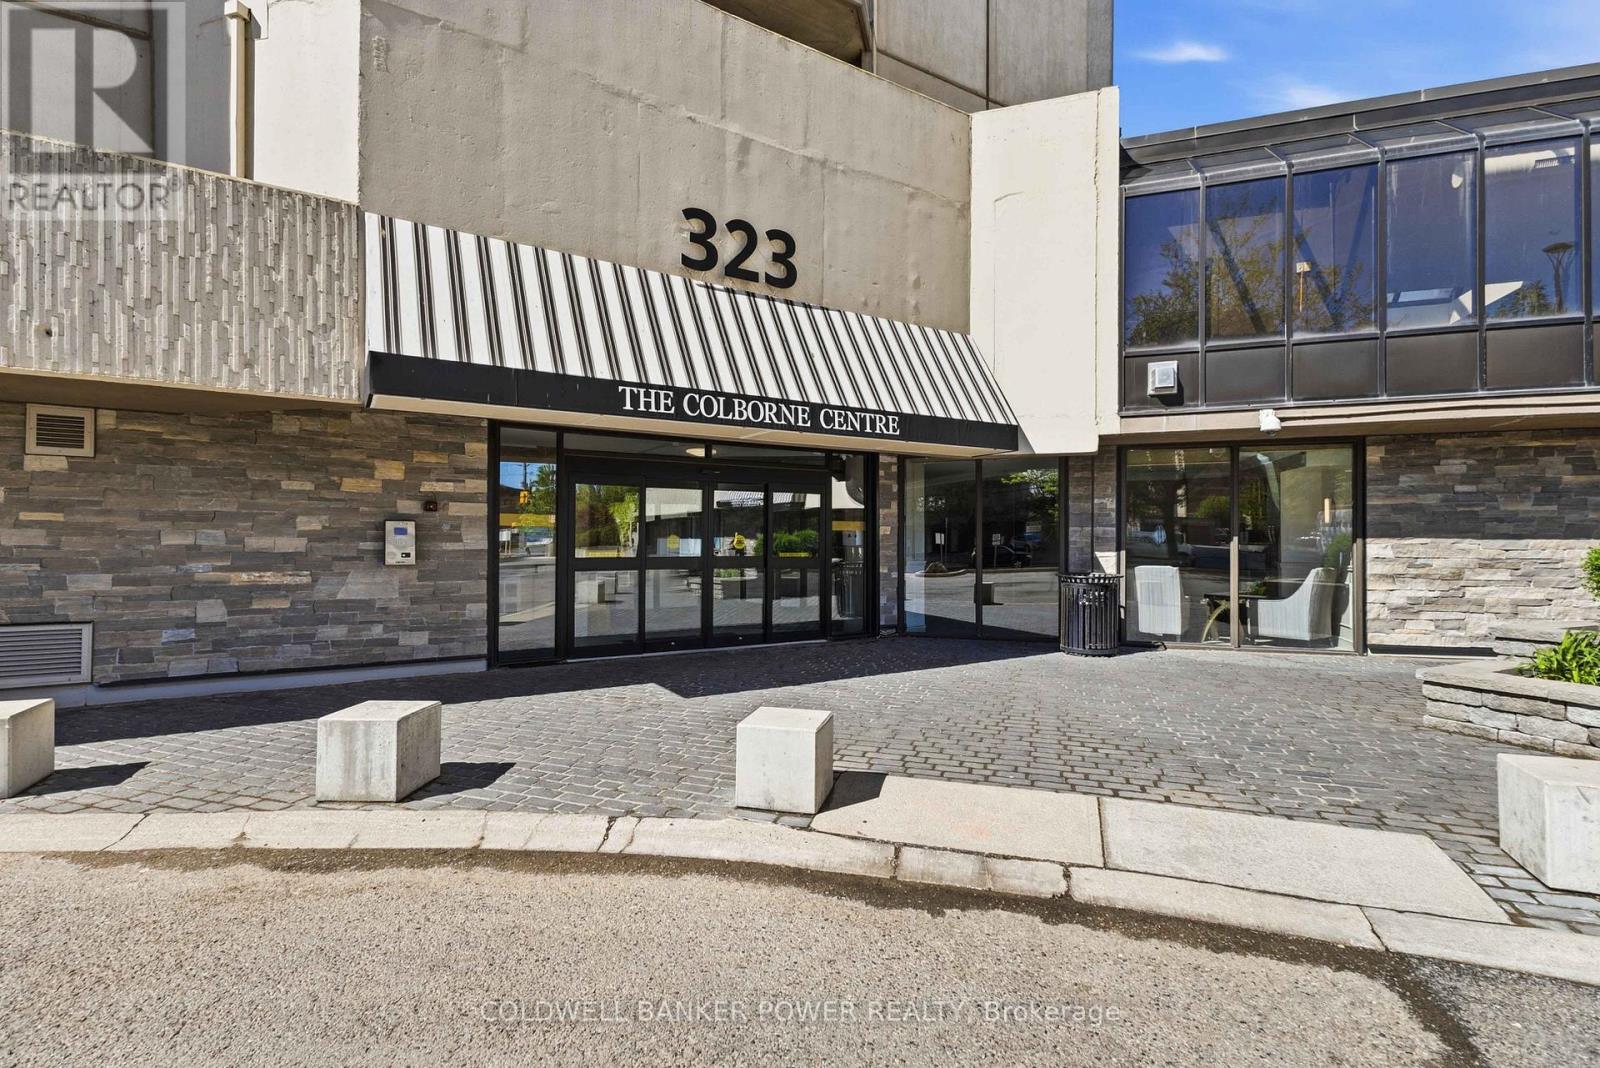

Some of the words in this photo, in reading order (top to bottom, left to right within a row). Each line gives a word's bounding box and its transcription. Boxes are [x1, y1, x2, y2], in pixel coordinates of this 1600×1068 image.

[681, 207, 797, 289] 323
[618, 386, 675, 414] THE
[683, 393, 811, 426] COLBORNE
[819, 408, 900, 435] CENTRE
